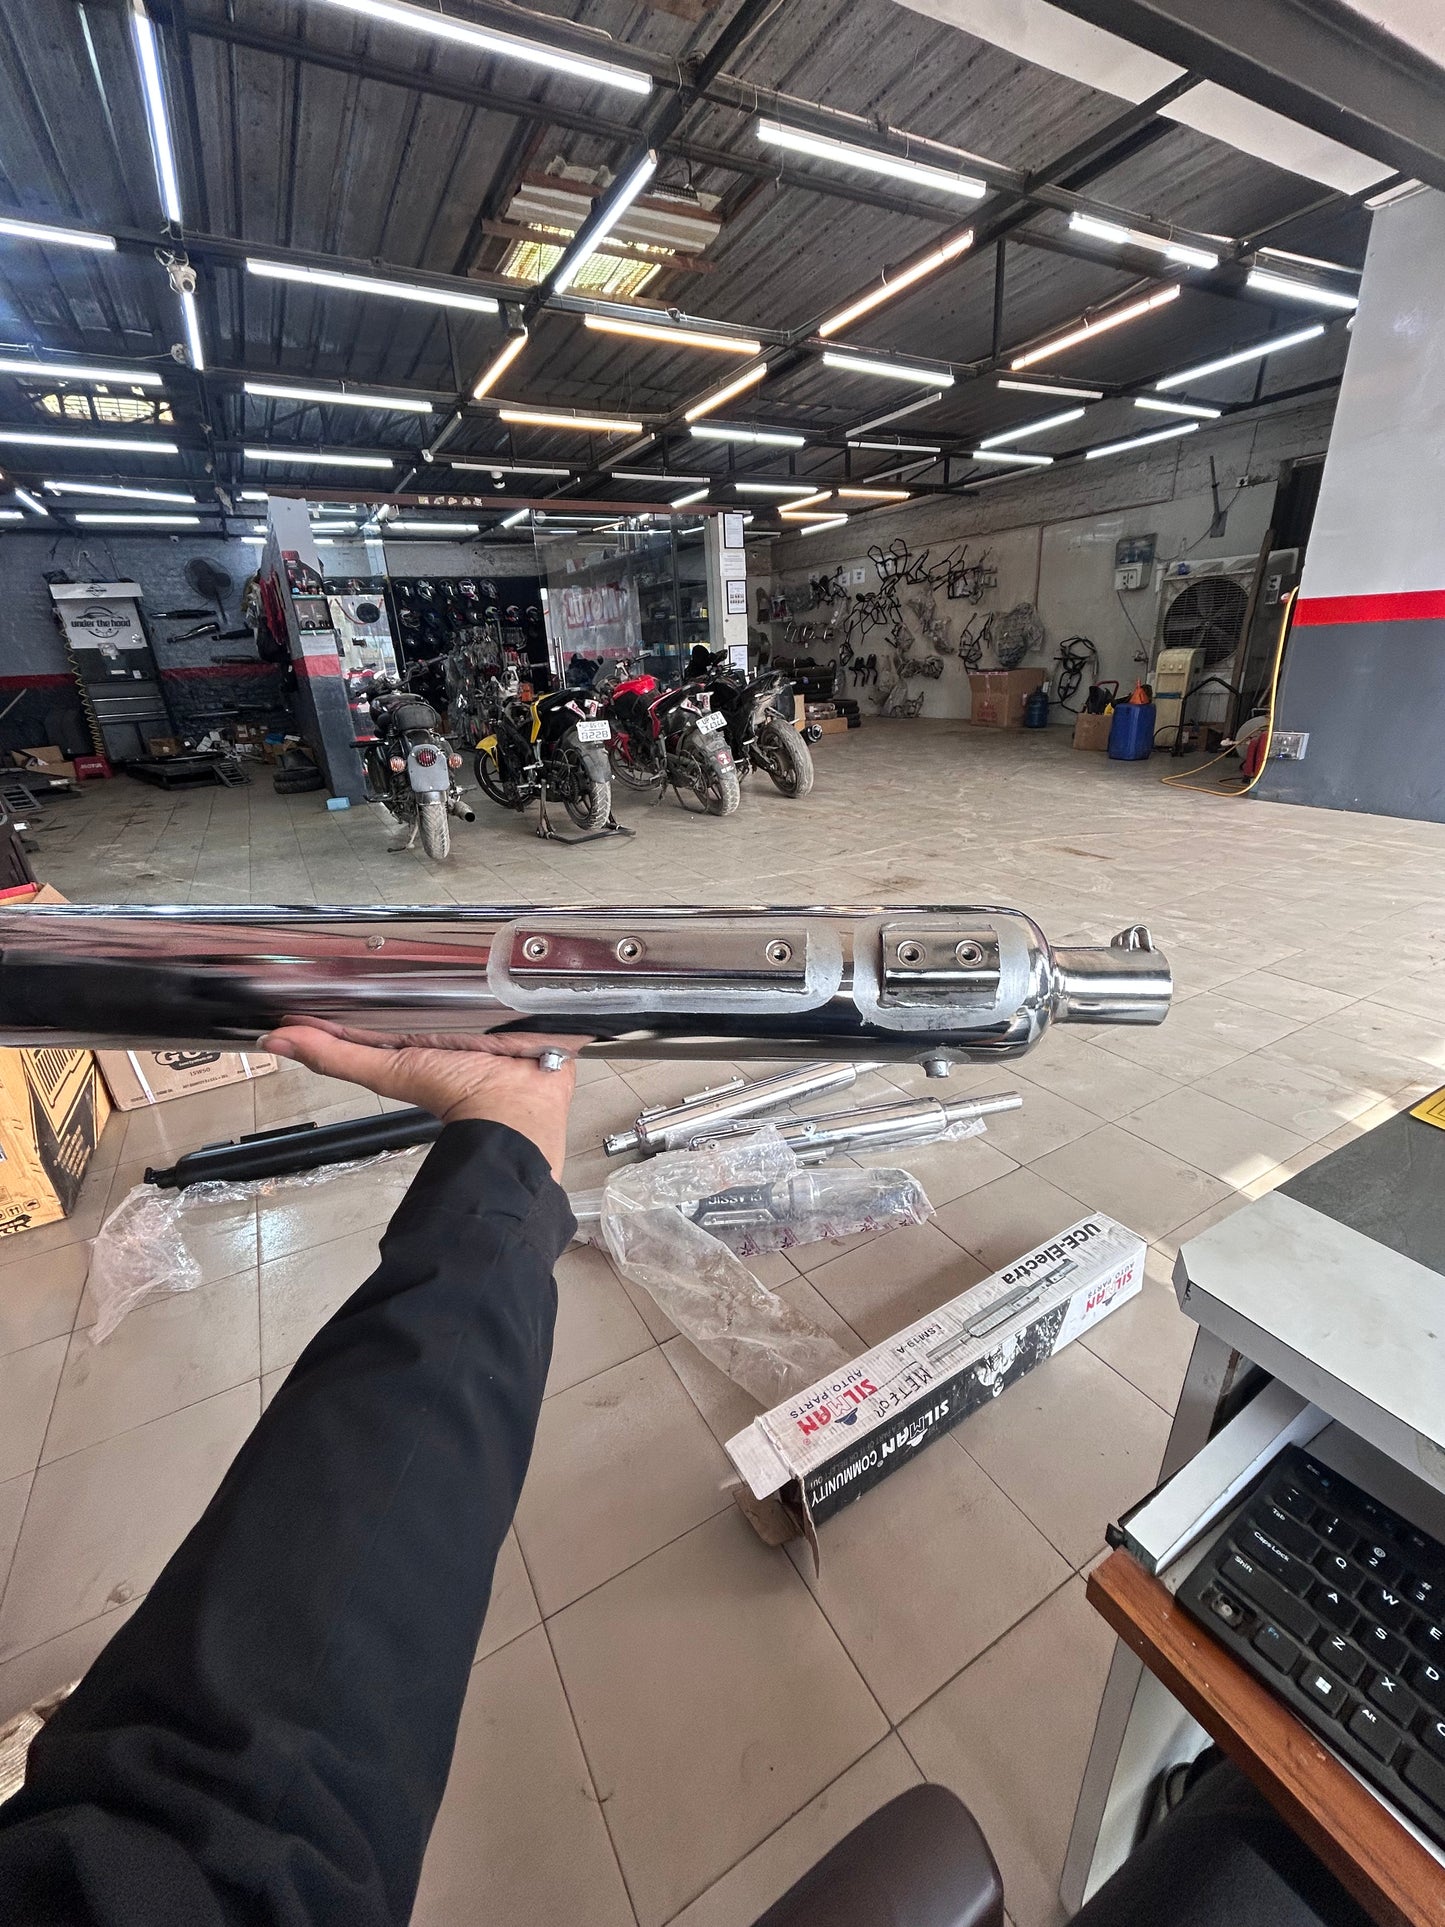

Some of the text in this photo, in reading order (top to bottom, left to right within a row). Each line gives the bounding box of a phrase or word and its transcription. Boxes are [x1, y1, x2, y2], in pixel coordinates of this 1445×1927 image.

[71, 619, 131, 628] under the hood
[1001, 1223, 1101, 1285] UCE-Electra
[1087, 1278, 1113, 1299] PARTS
[899, 1323, 942, 1354] LSM19-A
[790, 1369, 863, 1419] AUTO PARTS
[796, 1378, 878, 1436] SILMAN
[811, 1399, 950, 1507] SILMAN COMMUNITY
[1272, 1507, 1285, 1521] Tab
[1254, 1531, 1289, 1562] Caps Lock
[1373, 1547, 1386, 1558] @
[1234, 1555, 1253, 1574] Shift
[1335, 1556, 1347, 1569] Q
[1368, 1557, 1379, 1567] 2
[1327, 1592, 1339, 1604] A
[1381, 1589, 1399, 1606] W
[1415, 1591, 1426, 1601] 3
[1267, 1626, 1280, 1640] Fn
[1375, 1627, 1388, 1640] S
[1429, 1626, 1443, 1641] E
[1331, 1636, 1346, 1651] Z
[1425, 1666, 1440, 1681] D
[1381, 1676, 1396, 1693] X
[1361, 1708, 1377, 1724] Alt
